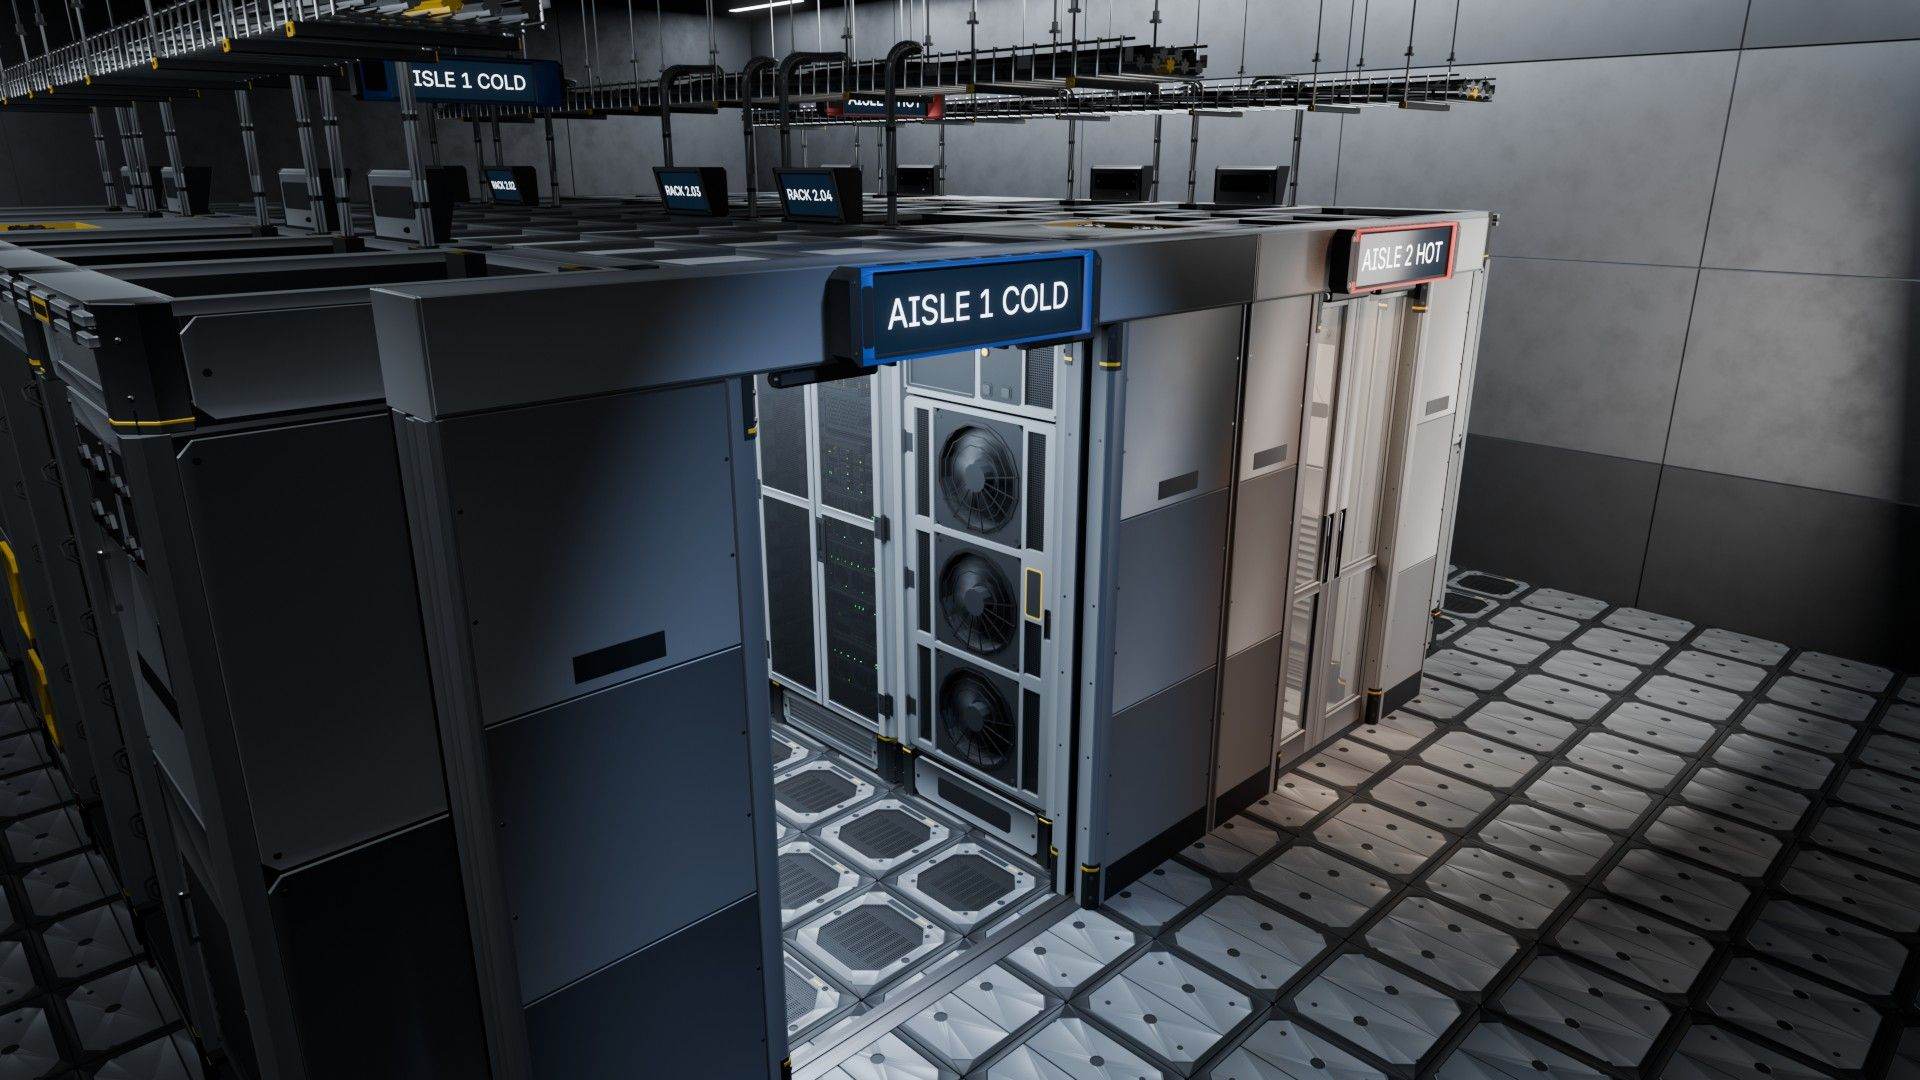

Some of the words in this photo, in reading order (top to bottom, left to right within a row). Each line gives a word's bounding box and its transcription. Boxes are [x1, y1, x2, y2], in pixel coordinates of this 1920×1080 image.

[412, 70, 457, 89] ISLE
[461, 72, 473, 89] 1
[476, 72, 527, 91] COLD
[664, 185, 686, 197] RACK
[684, 186, 702, 198] 2.03
[786, 188, 813, 202] RACK
[812, 189, 834, 202] 2.04
[1360, 245, 1403, 273] AISLE
[1404, 243, 1414, 267] 2
[1415, 240, 1444, 266] HOT
[887, 290, 971, 331] AISLE
[980, 288, 994, 319] 1
[1002, 281, 1069, 316] COLD
